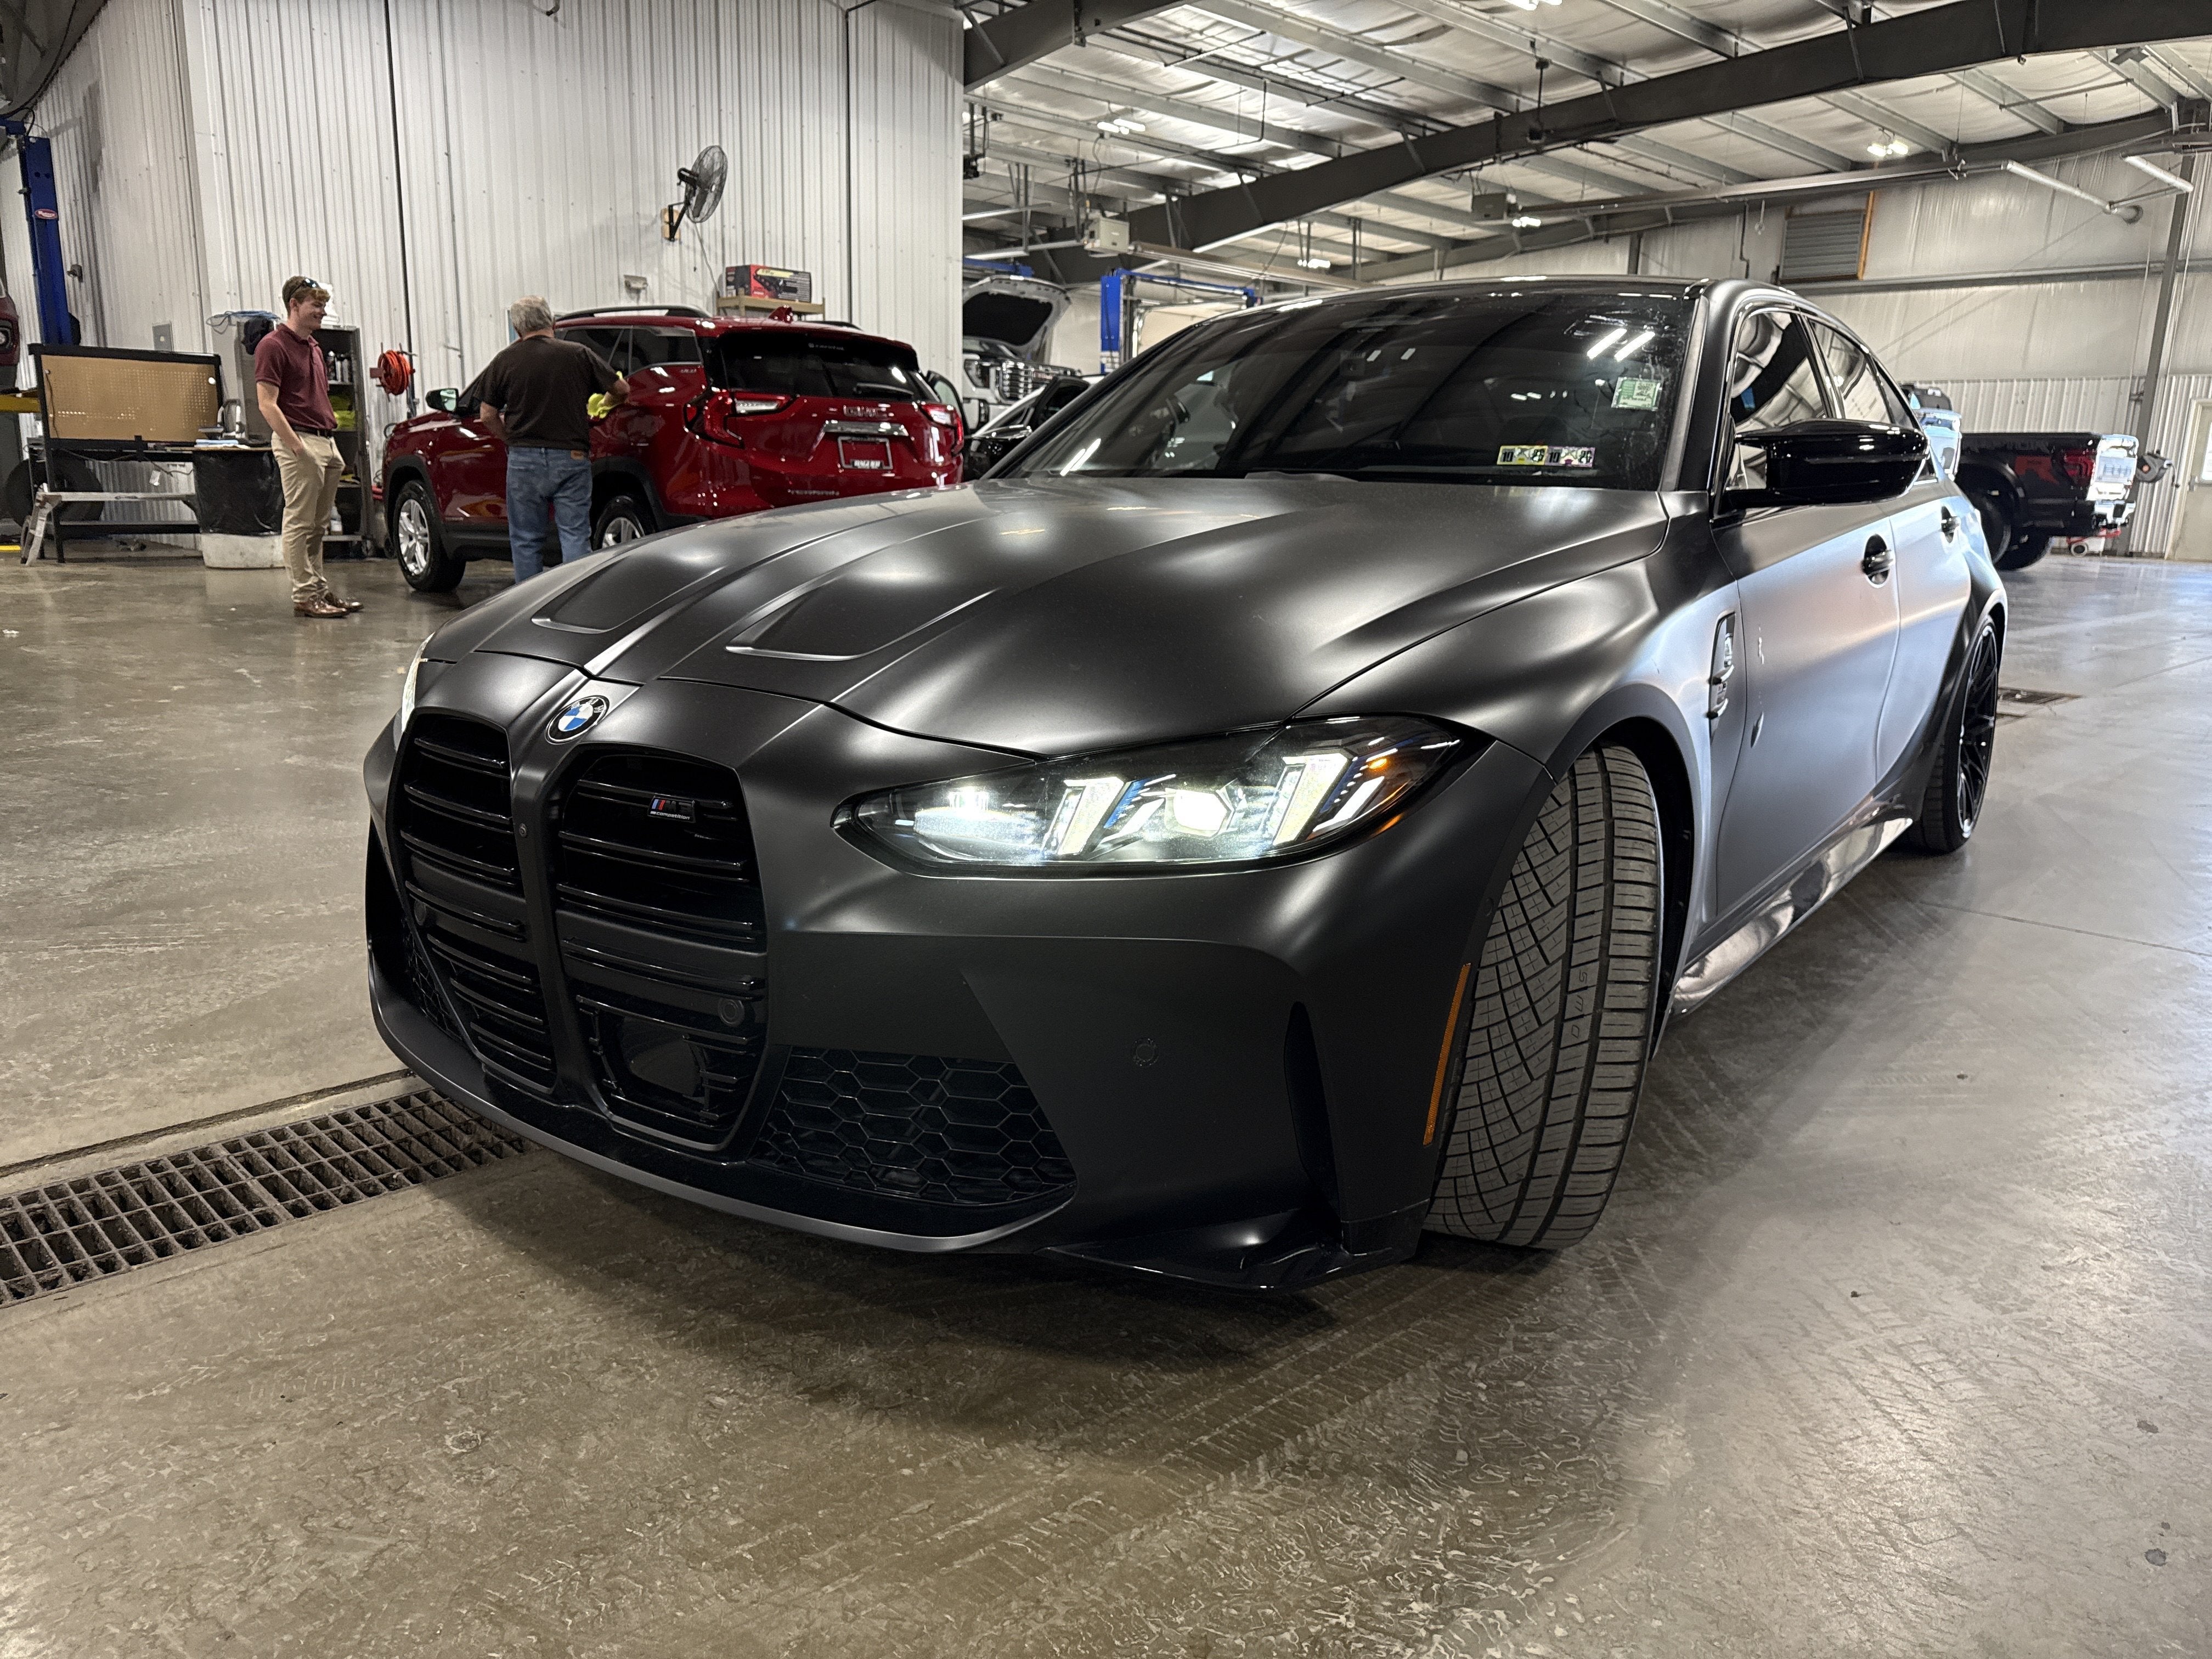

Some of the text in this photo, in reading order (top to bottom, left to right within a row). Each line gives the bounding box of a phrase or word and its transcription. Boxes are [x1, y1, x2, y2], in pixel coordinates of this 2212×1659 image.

[1503, 452, 1514, 462] 10
[1549, 452, 1560, 463] 10
[656, 811, 690, 820] competition
